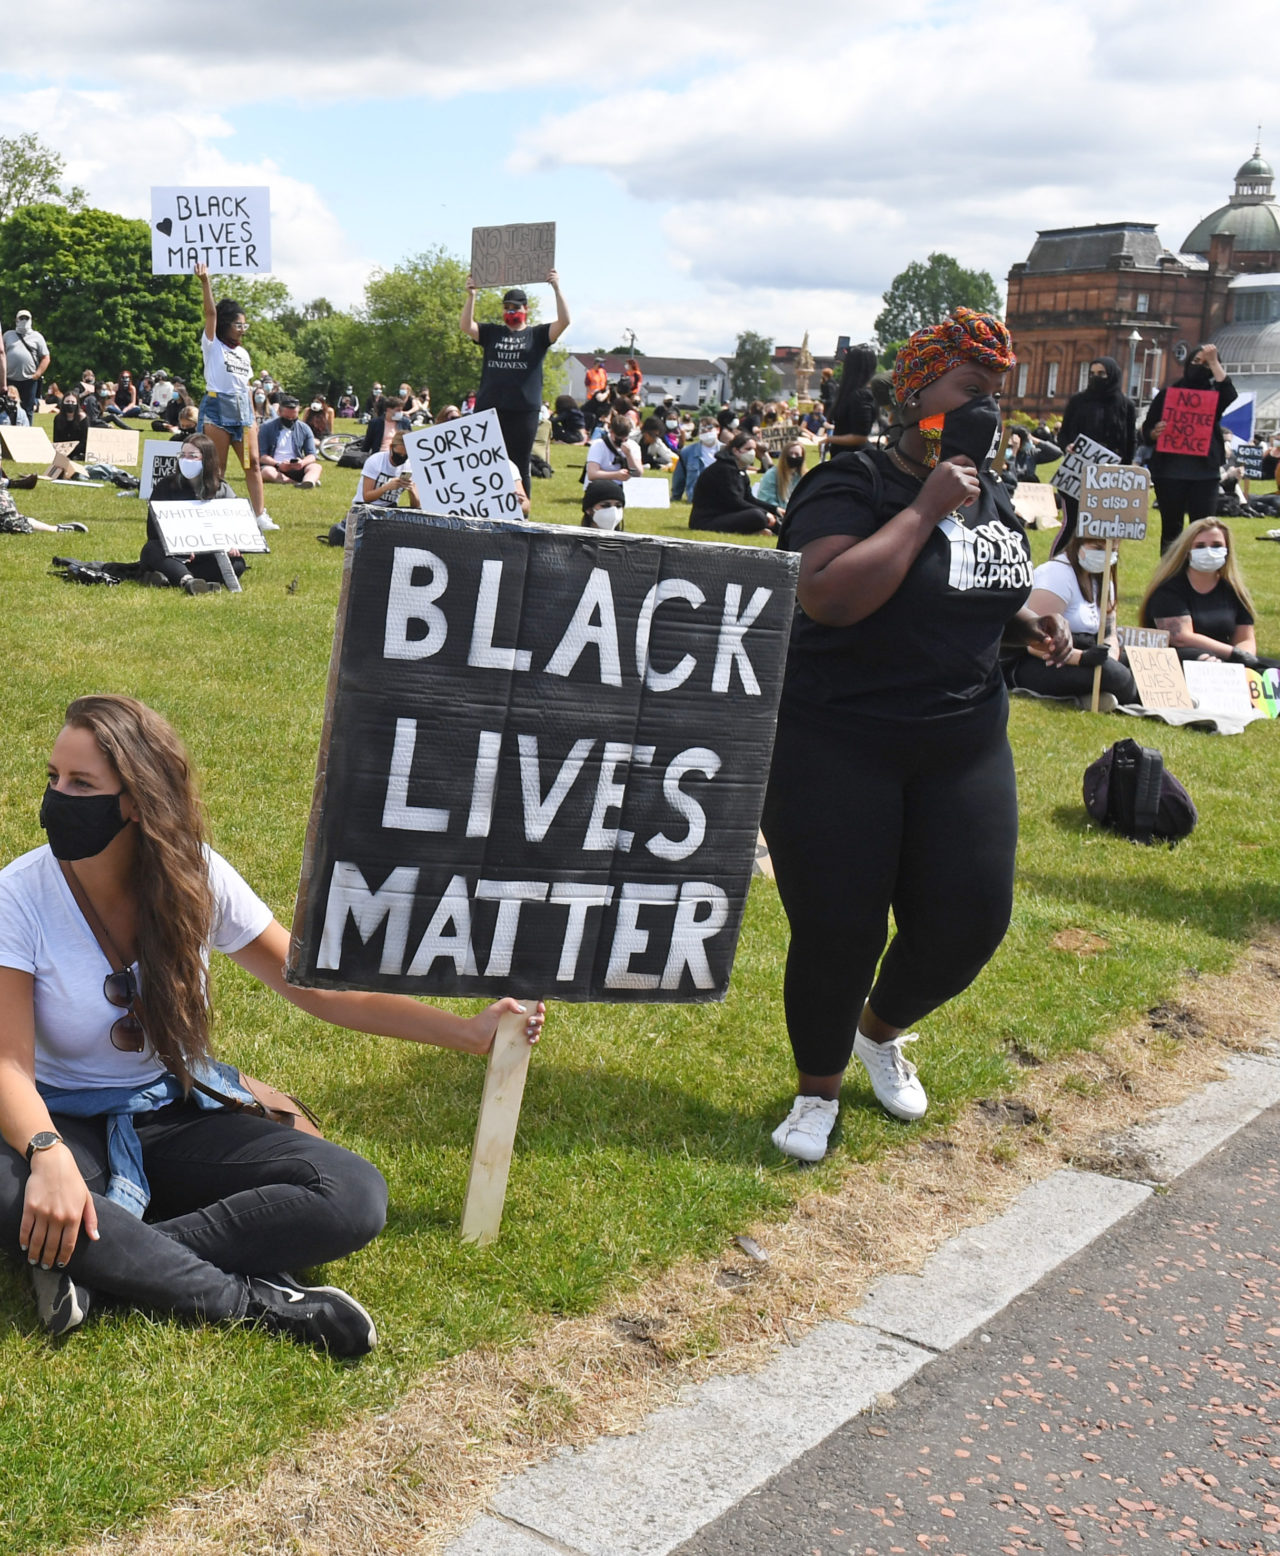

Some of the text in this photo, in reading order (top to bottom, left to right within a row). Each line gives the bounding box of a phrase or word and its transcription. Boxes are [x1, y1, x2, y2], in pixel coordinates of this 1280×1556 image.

[176, 195, 250, 221] BLACK
[184, 221, 253, 243] LIVES
[473, 228, 501, 255] NO
[168, 244, 259, 269] MATTER
[472, 254, 499, 284] NO
[497, 351, 520, 359] WITH
[1177, 391, 1201, 408] NO
[1163, 407, 1214, 427] JUSTICE
[416, 420, 488, 462] SORRY
[1172, 424, 1195, 437] NO
[1163, 434, 1207, 452] PEACE
[424, 446, 505, 484] IT TOOK
[435, 472, 503, 504] US SO
[1086, 465, 1146, 491] Racism
[491, 492, 517, 513] TO
[1087, 494, 1140, 509] is also a
[156, 508, 206, 520] WHITE
[166, 533, 267, 548] VIOLENCE
[977, 536, 1028, 564] BLACK
[383, 546, 773, 696] BLACK
[1117, 626, 1168, 649] SILENCE
[1131, 649, 1178, 673] BLACK
[1141, 672, 1176, 688] LIVES
[1142, 690, 1188, 708] MATTER
[381, 717, 722, 862] LIVES
[316, 861, 730, 990] MATTER
